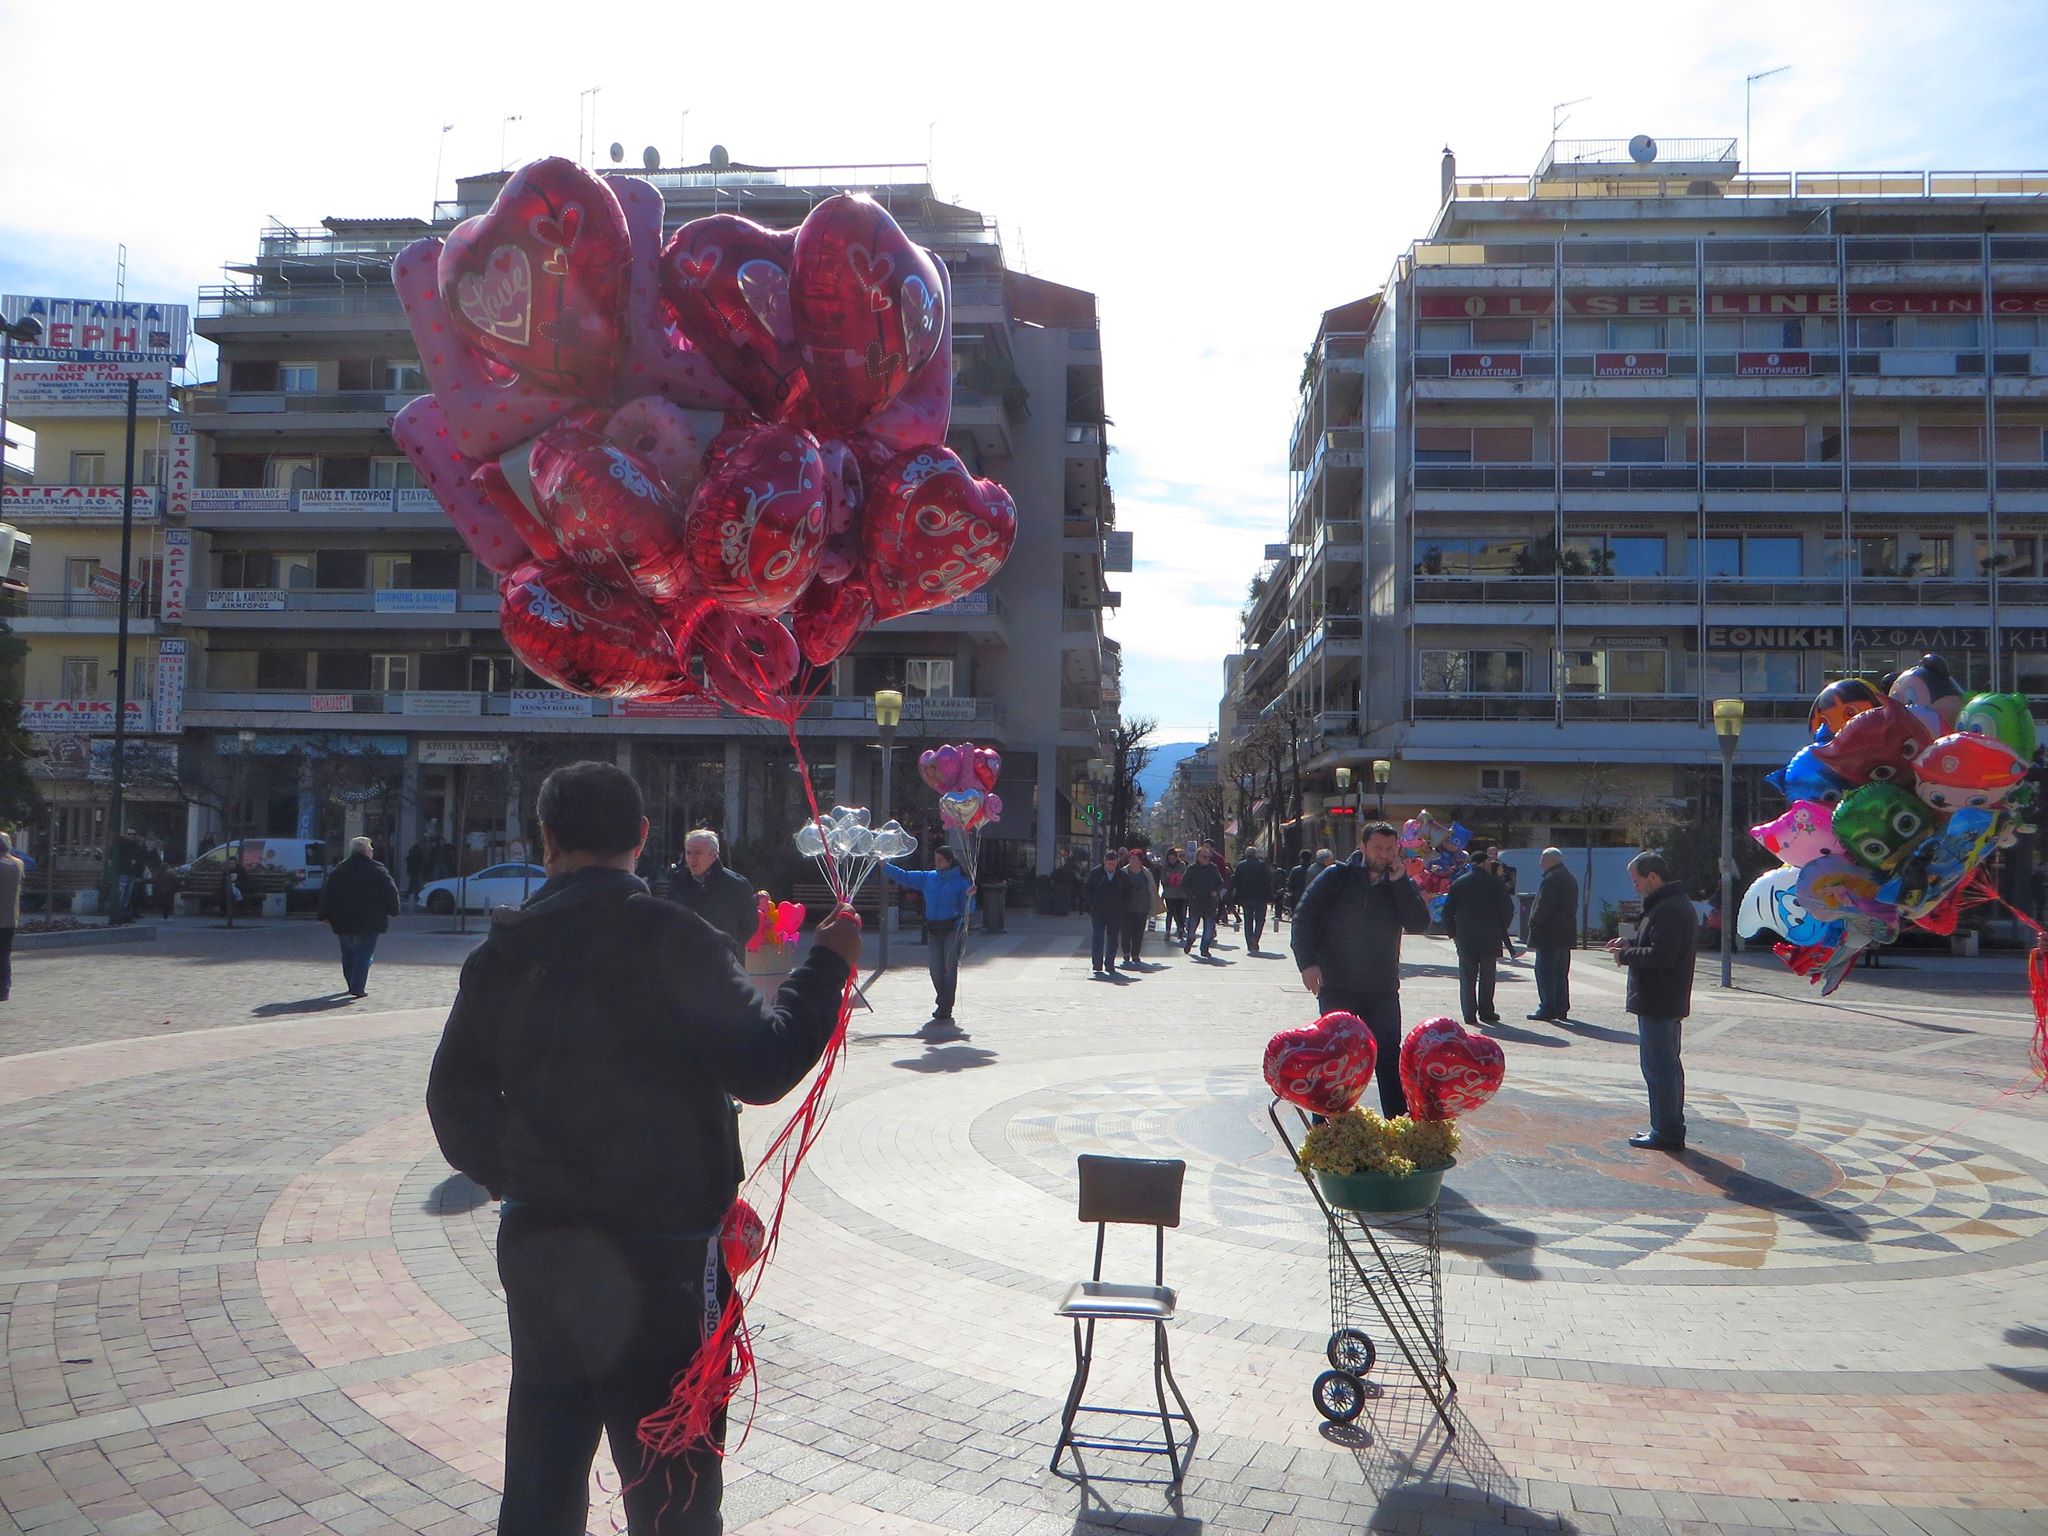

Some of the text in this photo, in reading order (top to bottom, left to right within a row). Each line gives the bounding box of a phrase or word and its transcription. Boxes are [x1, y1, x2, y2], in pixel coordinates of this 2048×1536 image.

[29, 298, 161, 321] ΑΓΓΛΙΚΑ
[1509, 294, 2048, 314] LASERLINE CLINCS
[57, 363, 119, 372] ΚΕΝΤΡΟ
[1454, 368, 1518, 377] ΑΔΥΝΑΤΙΣΜΑ
[1599, 367, 1664, 376] ΑΠΟΤΡΙΧΩΣΗ
[1741, 366, 1807, 375] ΑΝΤΙΓΗΡΑΝΣΗ
[13, 371, 164, 381] ΑΓΓΛΙΚΗΣ ΓΛΩΣΣΑΣ
[172, 436, 190, 513] ΙΤΑΛΙΚΑ
[1, 487, 150, 498] ΑΓΓΛΙΚΑ
[242, 489, 280, 499] ΝΙΚΟΛΑΟΣ
[301, 490, 392, 501] ΠΑΝΟΣ ΣΤ. ΤΖΟΥΡΟΣ
[2, 498, 70, 506] ΒΑΣΙΛΙΚΗ
[115, 498, 153, 506] ΛΡΗ
[166, 531, 191, 545] ΛΕΡΗ
[166, 548, 186, 619] ΑΓΓΛΙΚΑ
[1709, 627, 2047, 648] ΕΘΝΙΚΗ ΑΣΦΑΛΙΣΤΙΚΗ
[160, 641, 185, 653] ΛΕΡΗ
[166, 665, 176, 731] MICHIGAN
[706, 1257, 717, 1293] LIFE
